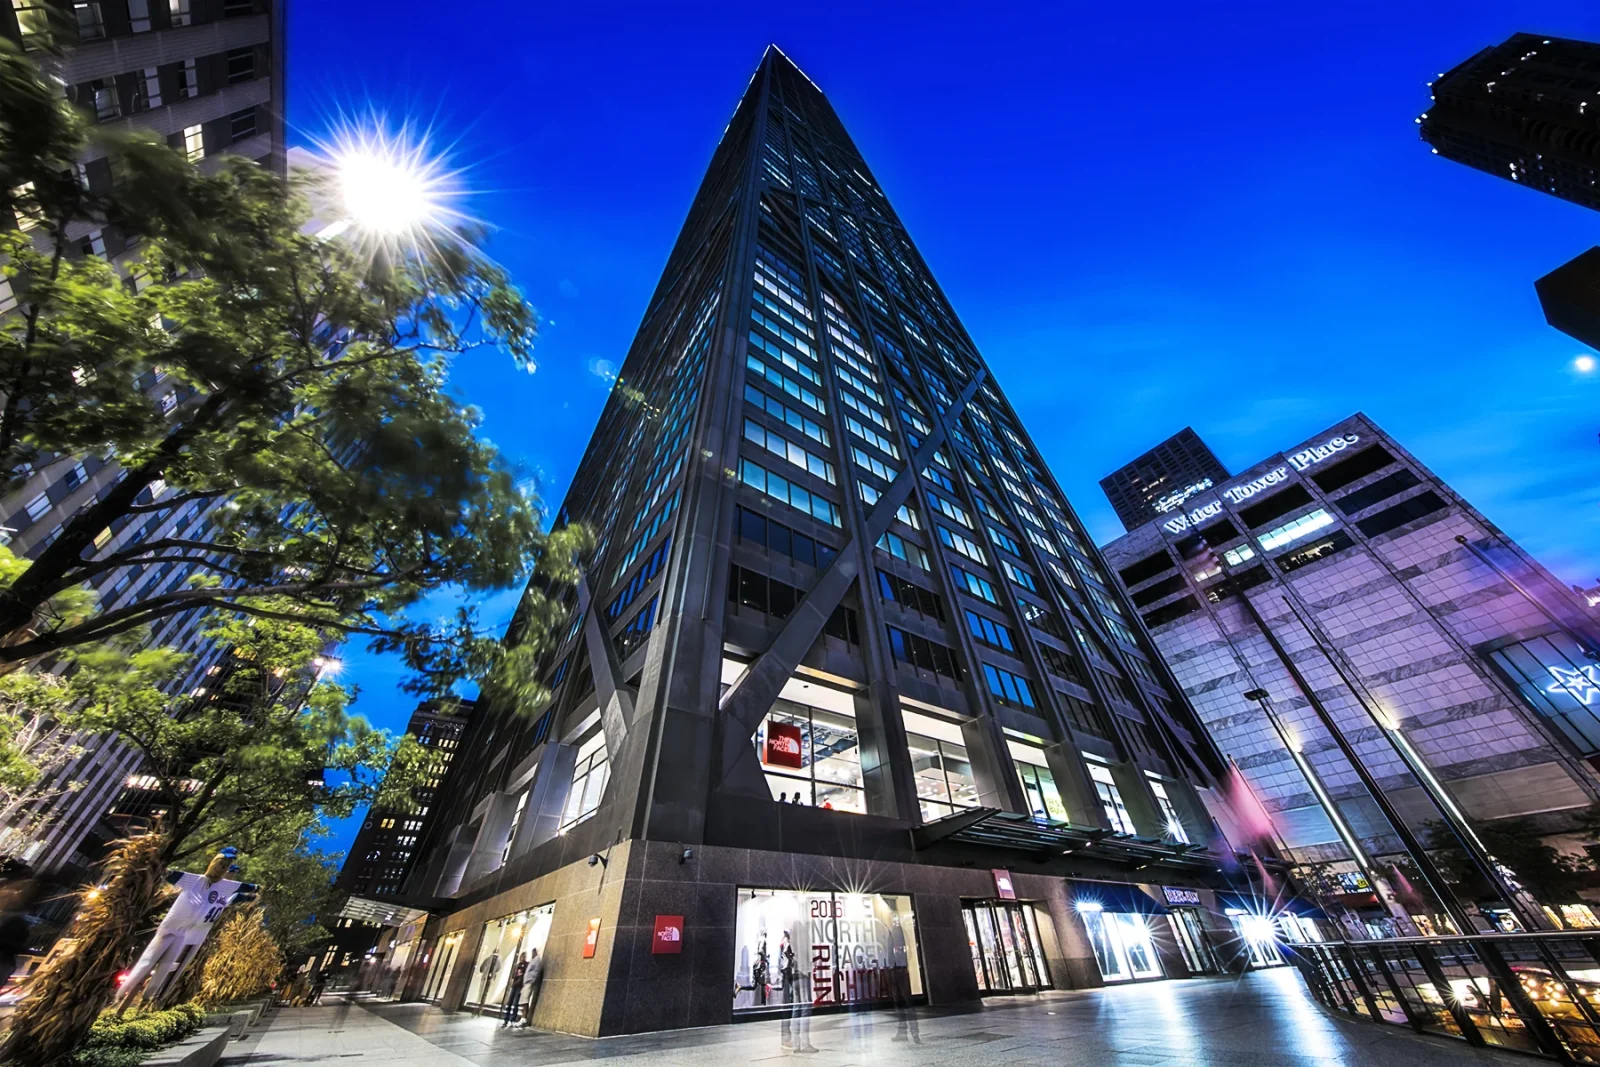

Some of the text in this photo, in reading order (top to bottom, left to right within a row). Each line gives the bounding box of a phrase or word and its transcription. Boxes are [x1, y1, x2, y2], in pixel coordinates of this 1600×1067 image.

[1163, 431, 1359, 535] Water Tower Place
[811, 900, 843, 918] 2016
[811, 919, 875, 943] NORTH
[811, 945, 834, 1006] RUN
